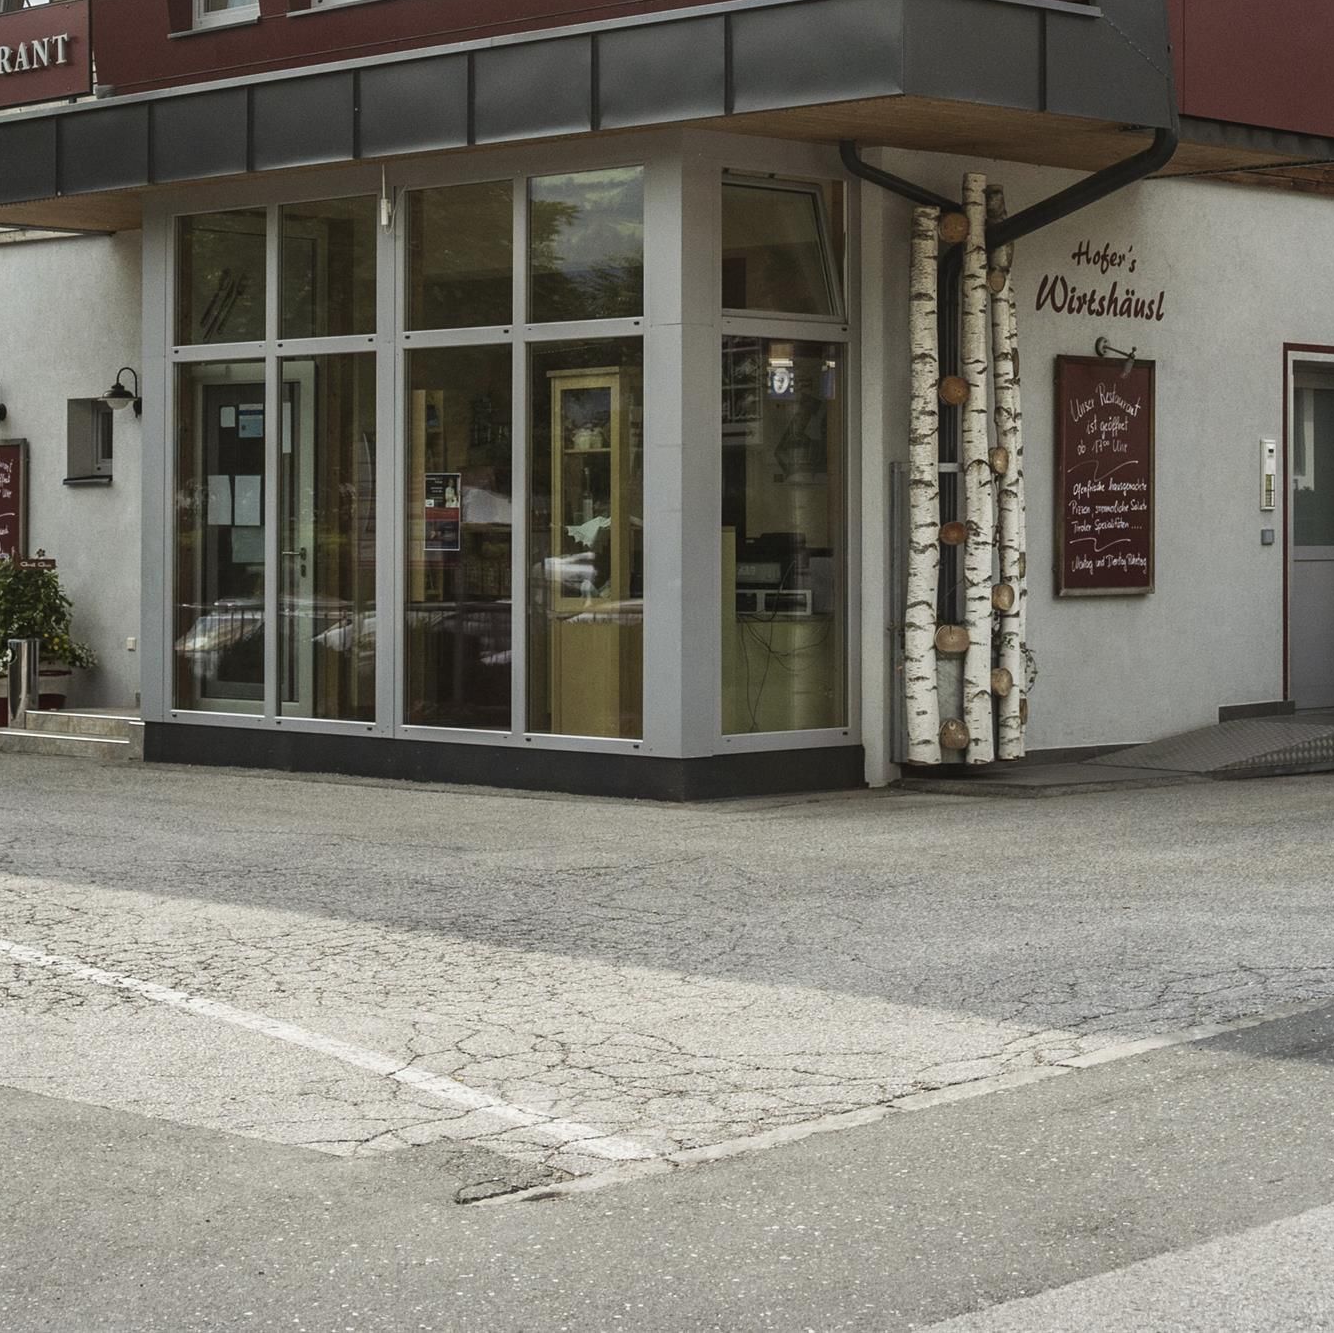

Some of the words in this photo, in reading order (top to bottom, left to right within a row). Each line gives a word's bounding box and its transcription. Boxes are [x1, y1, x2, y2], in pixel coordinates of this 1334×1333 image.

[1035, 274, 1165, 322] Wirtshäusl
[1069, 397, 1095, 422] Unser
[1095, 382, 1141, 417] Restaurant
[1086, 413, 1098, 435] ist
[1100, 415, 1128, 440] geöffnet
[1077, 439, 1086, 456] ab
[1112, 439, 1128, 453] Uhr
[1096, 554, 1105, 568] und
